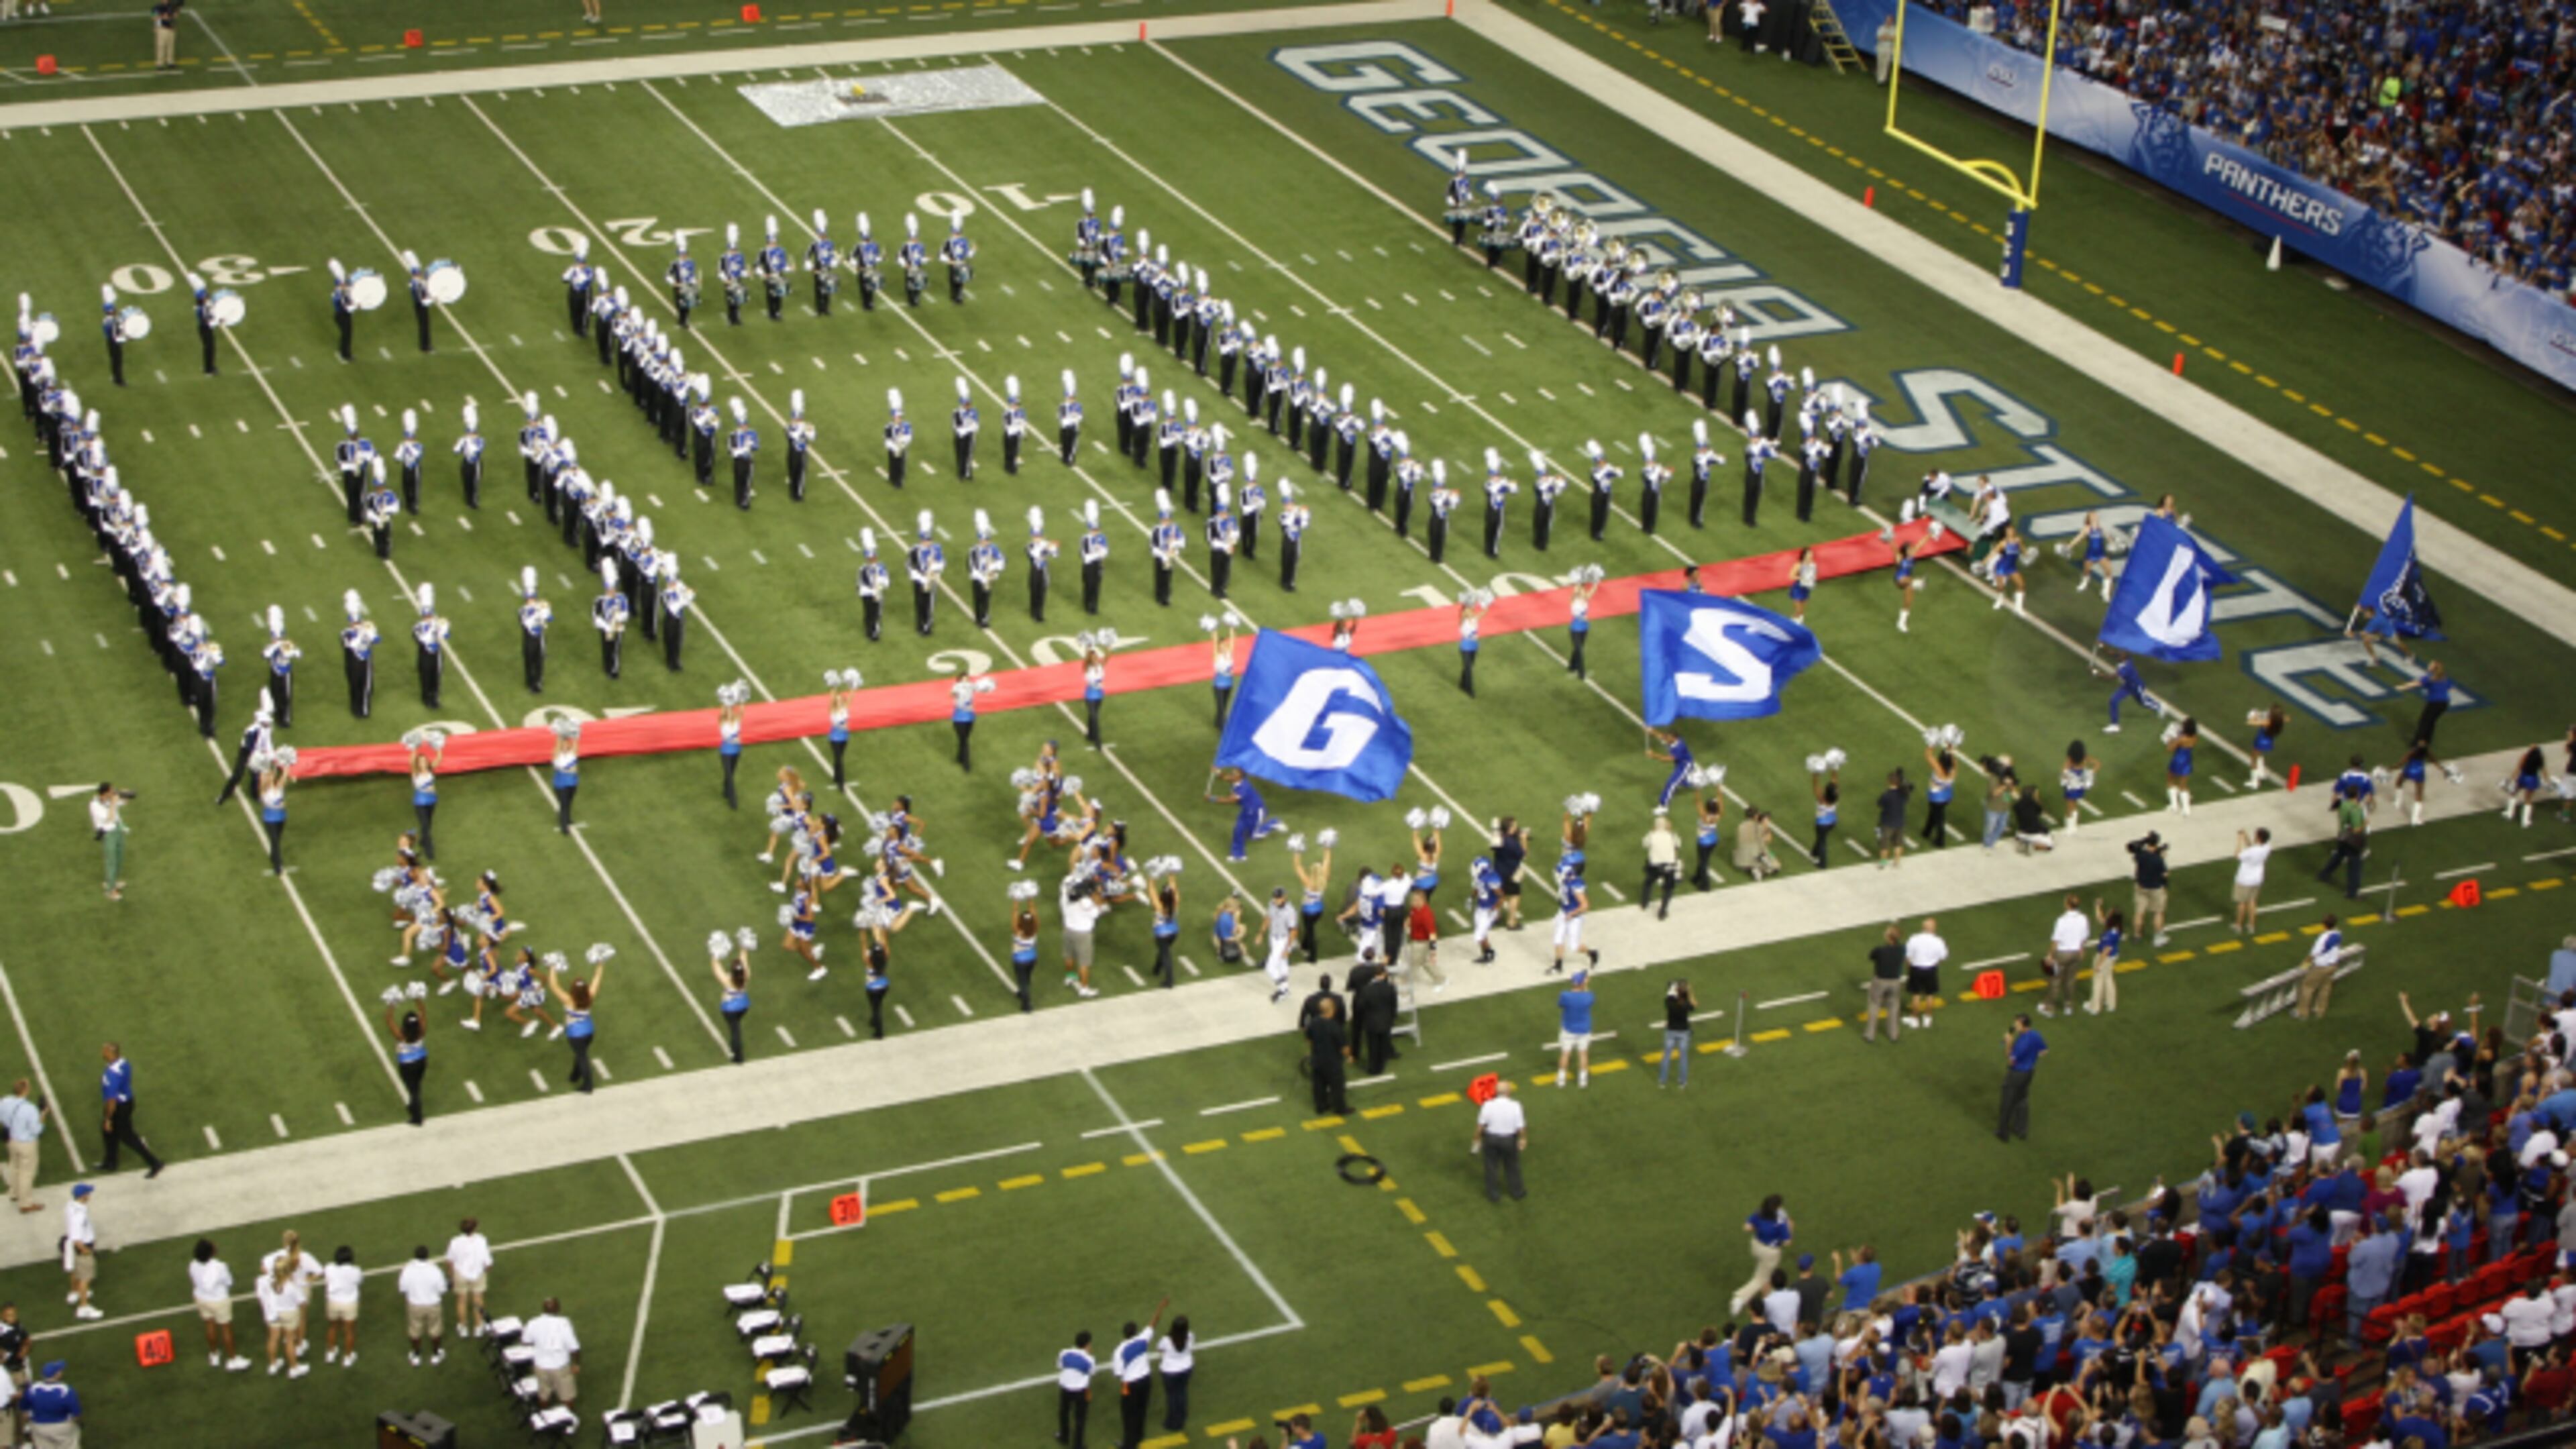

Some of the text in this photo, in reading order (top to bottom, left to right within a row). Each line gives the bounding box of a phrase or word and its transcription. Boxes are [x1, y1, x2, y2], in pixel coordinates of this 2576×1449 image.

[1270, 40, 1858, 343] GEORGIA
[2203, 152, 2345, 236] PANTHERS
[1674, 607, 1796, 703] S
[1252, 667, 1384, 770] G
[144, 1335, 169, 1360] 40
